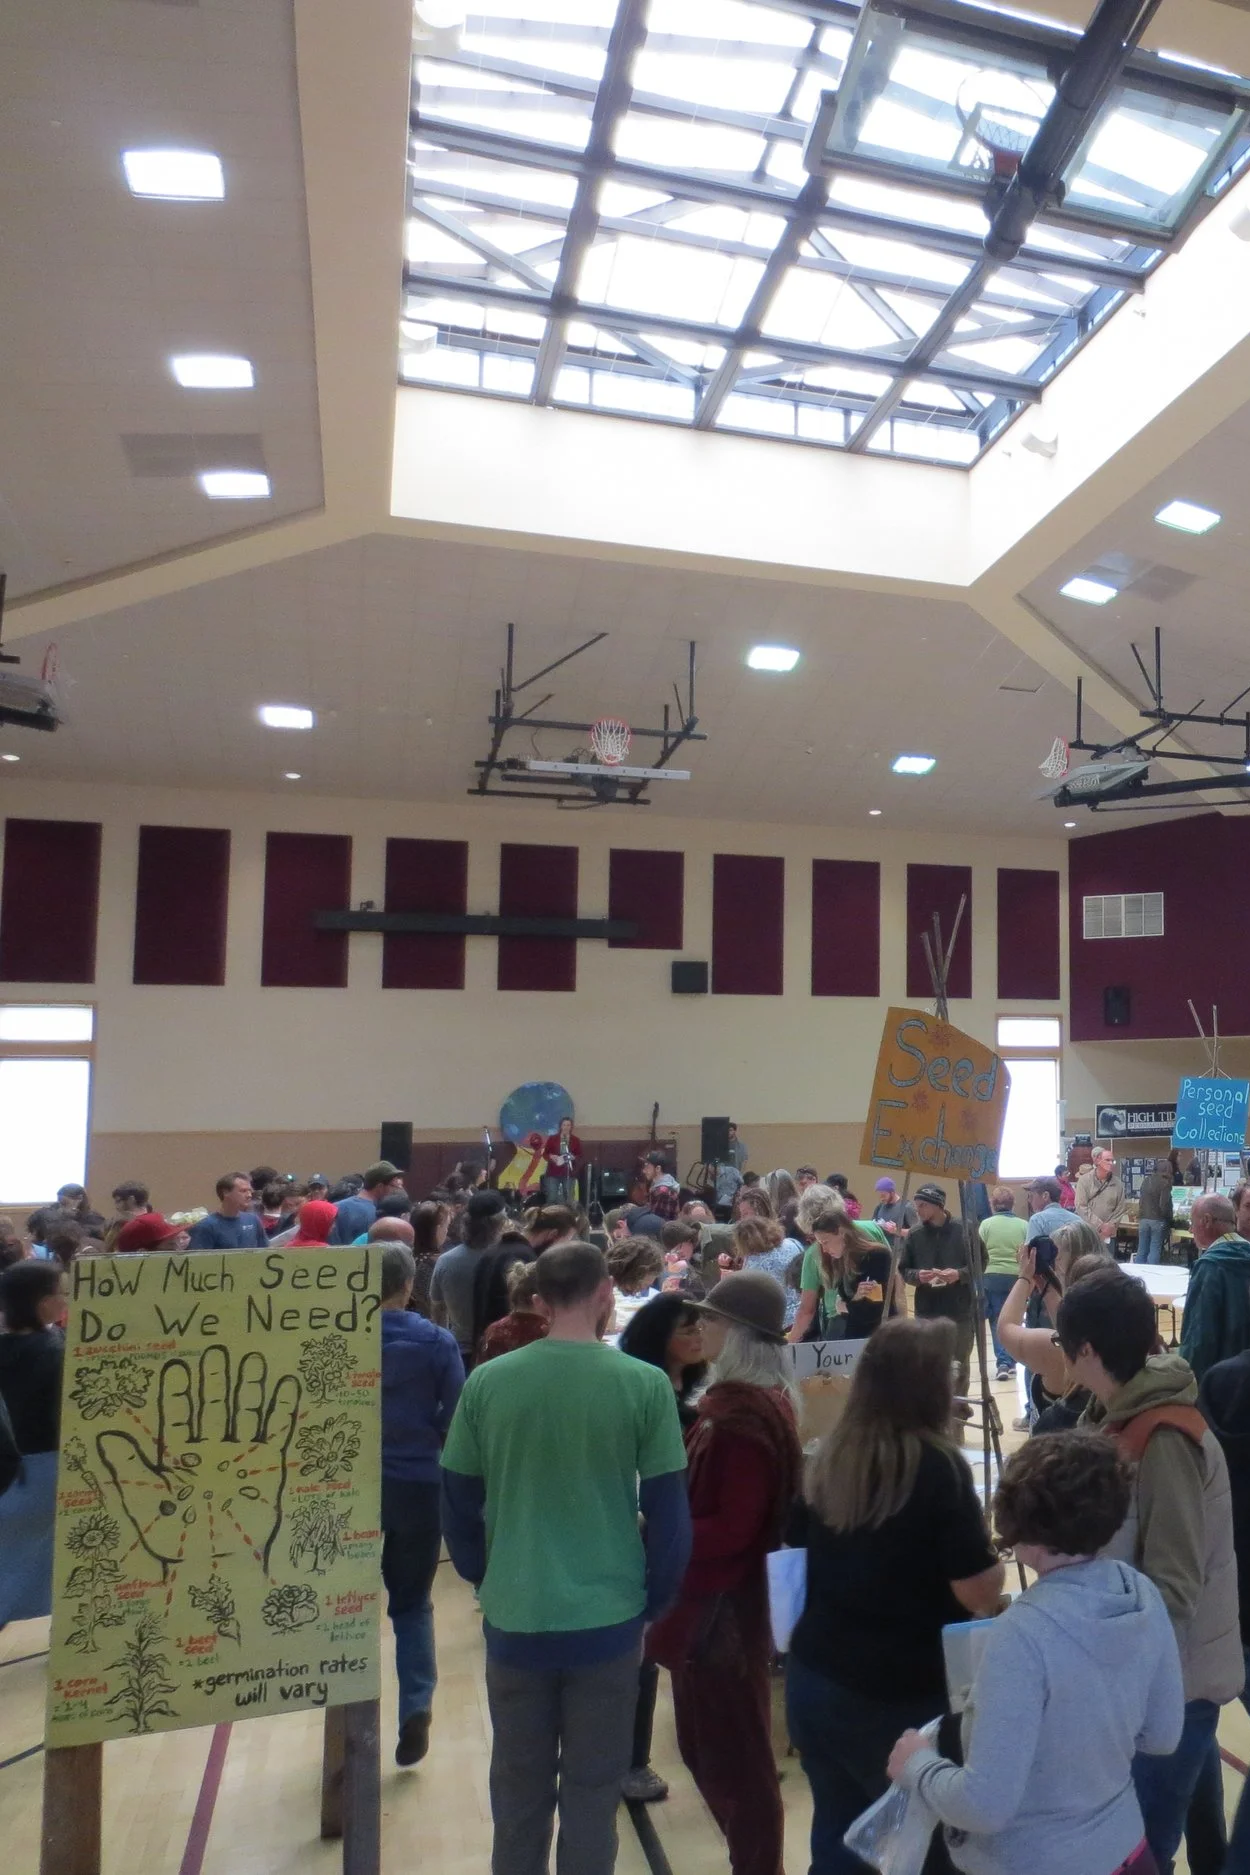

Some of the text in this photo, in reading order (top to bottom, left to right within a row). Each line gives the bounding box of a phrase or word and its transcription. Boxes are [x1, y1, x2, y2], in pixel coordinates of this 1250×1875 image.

[888, 1019, 998, 1101] Seed
[1181, 1079, 1250, 1104] Personal
[1127, 1111, 1177, 1123] HIGH TID
[1175, 1116, 1246, 1145] Collections
[163, 1255, 234, 1294] Much
[260, 1250, 369, 1293] Seed
[80, 1293, 381, 1344] Do We Need?
[812, 1343, 853, 1368] Your
[334, 1603, 363, 1616] seed
[319, 1652, 369, 1675] rates
[235, 1681, 329, 1707] will vary
